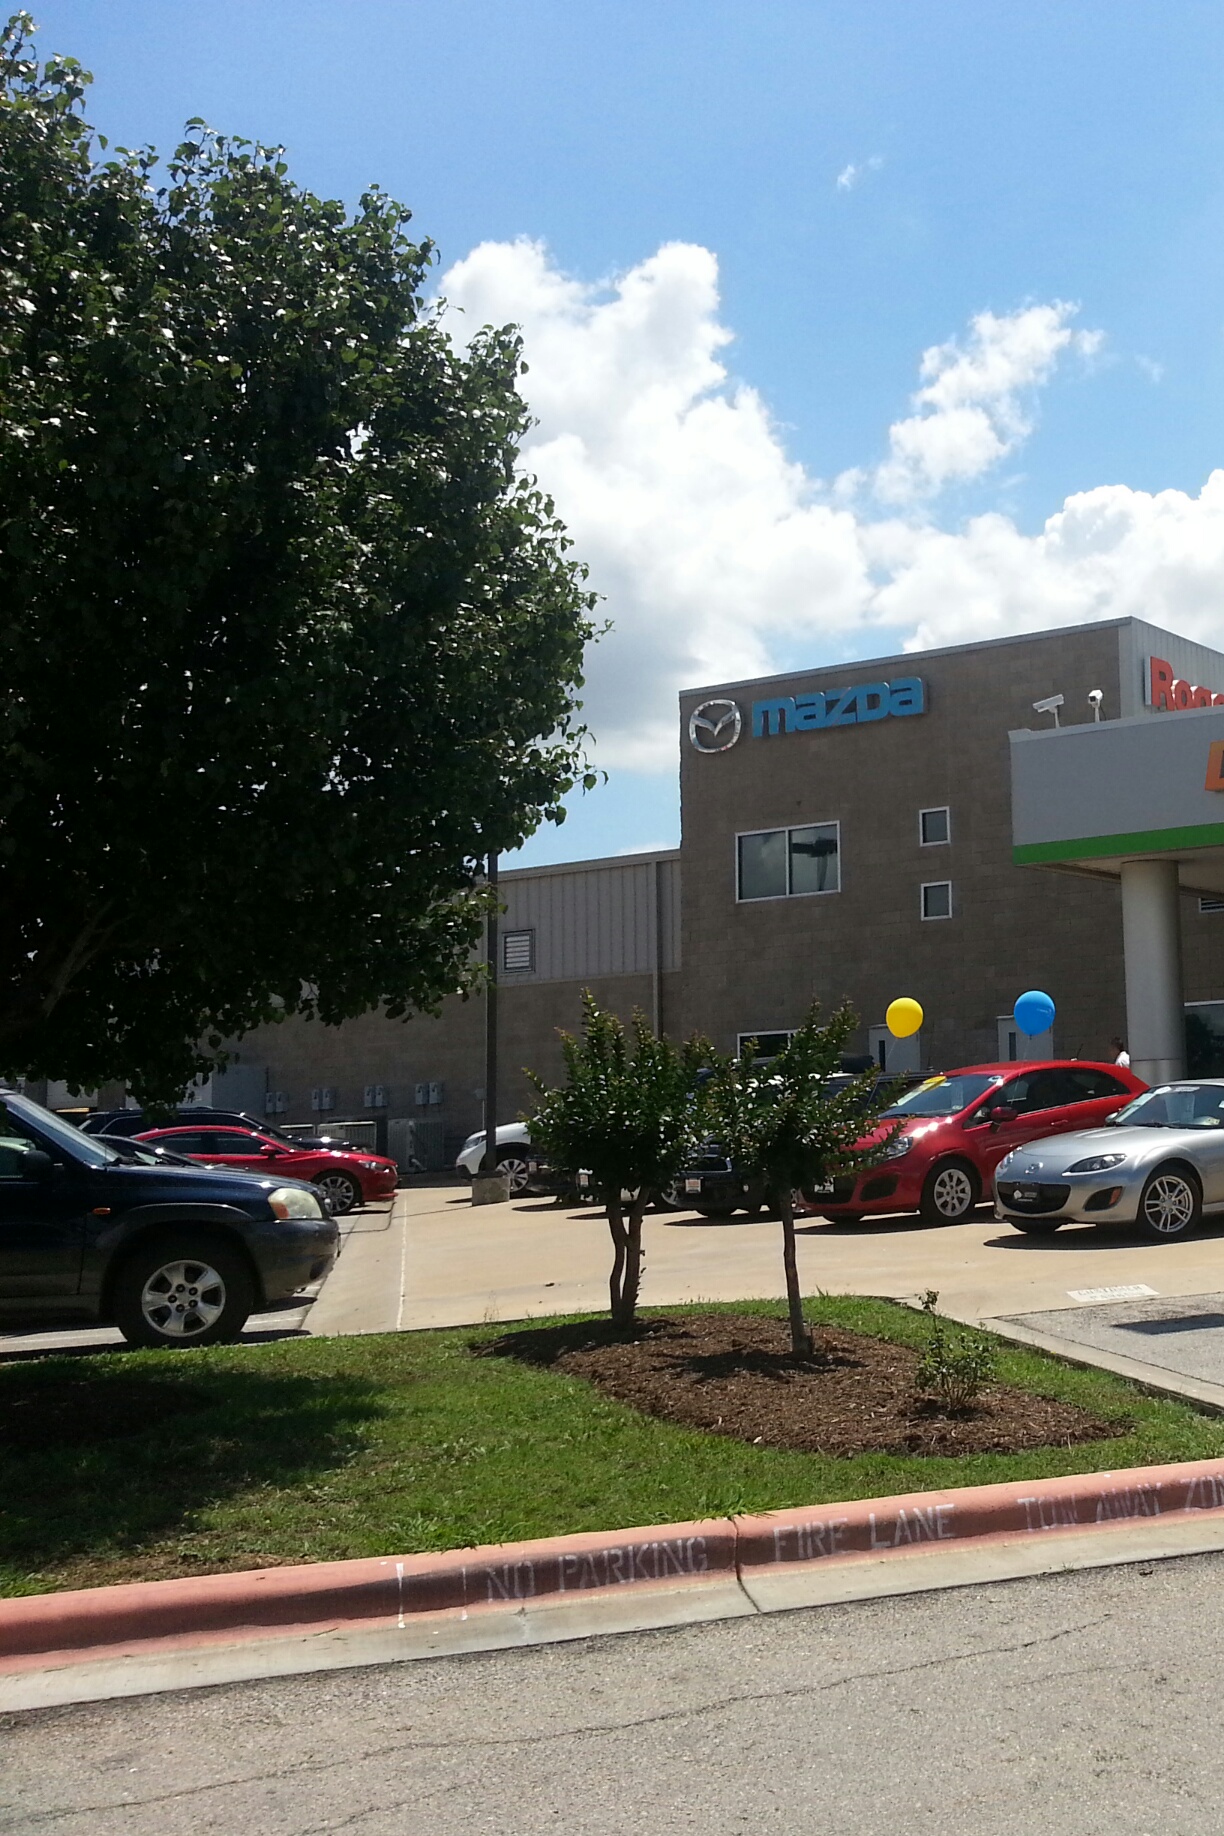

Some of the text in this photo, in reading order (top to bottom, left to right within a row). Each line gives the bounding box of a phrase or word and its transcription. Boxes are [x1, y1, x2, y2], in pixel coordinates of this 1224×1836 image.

[486, 1560, 535, 1603] NO
[558, 1537, 708, 1592] PARKING
[773, 1517, 848, 1561] FIRE
[869, 1503, 955, 1549] LANE
